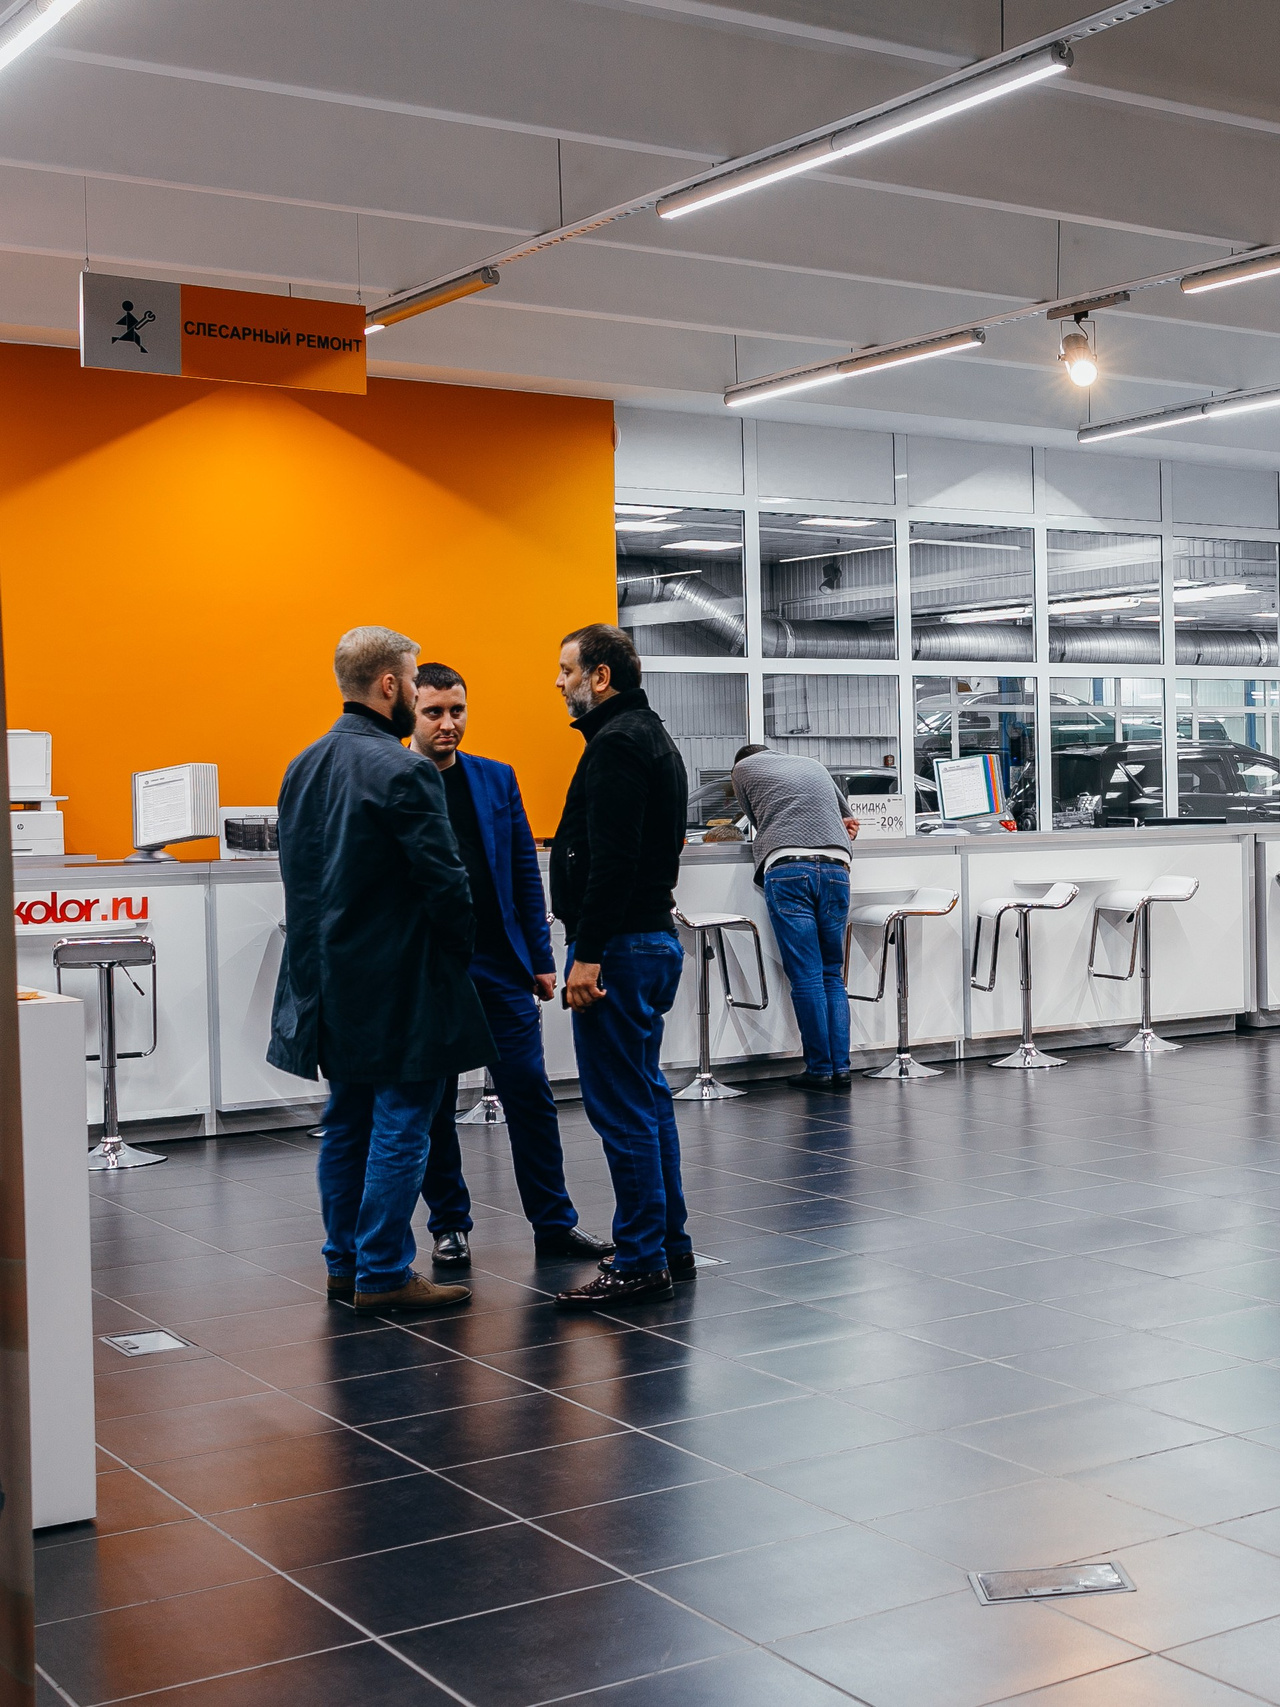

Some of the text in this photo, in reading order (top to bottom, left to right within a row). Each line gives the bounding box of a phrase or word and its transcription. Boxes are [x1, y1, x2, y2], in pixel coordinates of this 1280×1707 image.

[184, 320, 362, 353] СЛЕСАРНЫЙ РЕМОНТ
[850, 802, 887, 813] СКИДКА
[876, 816, 904, 827] -20%
